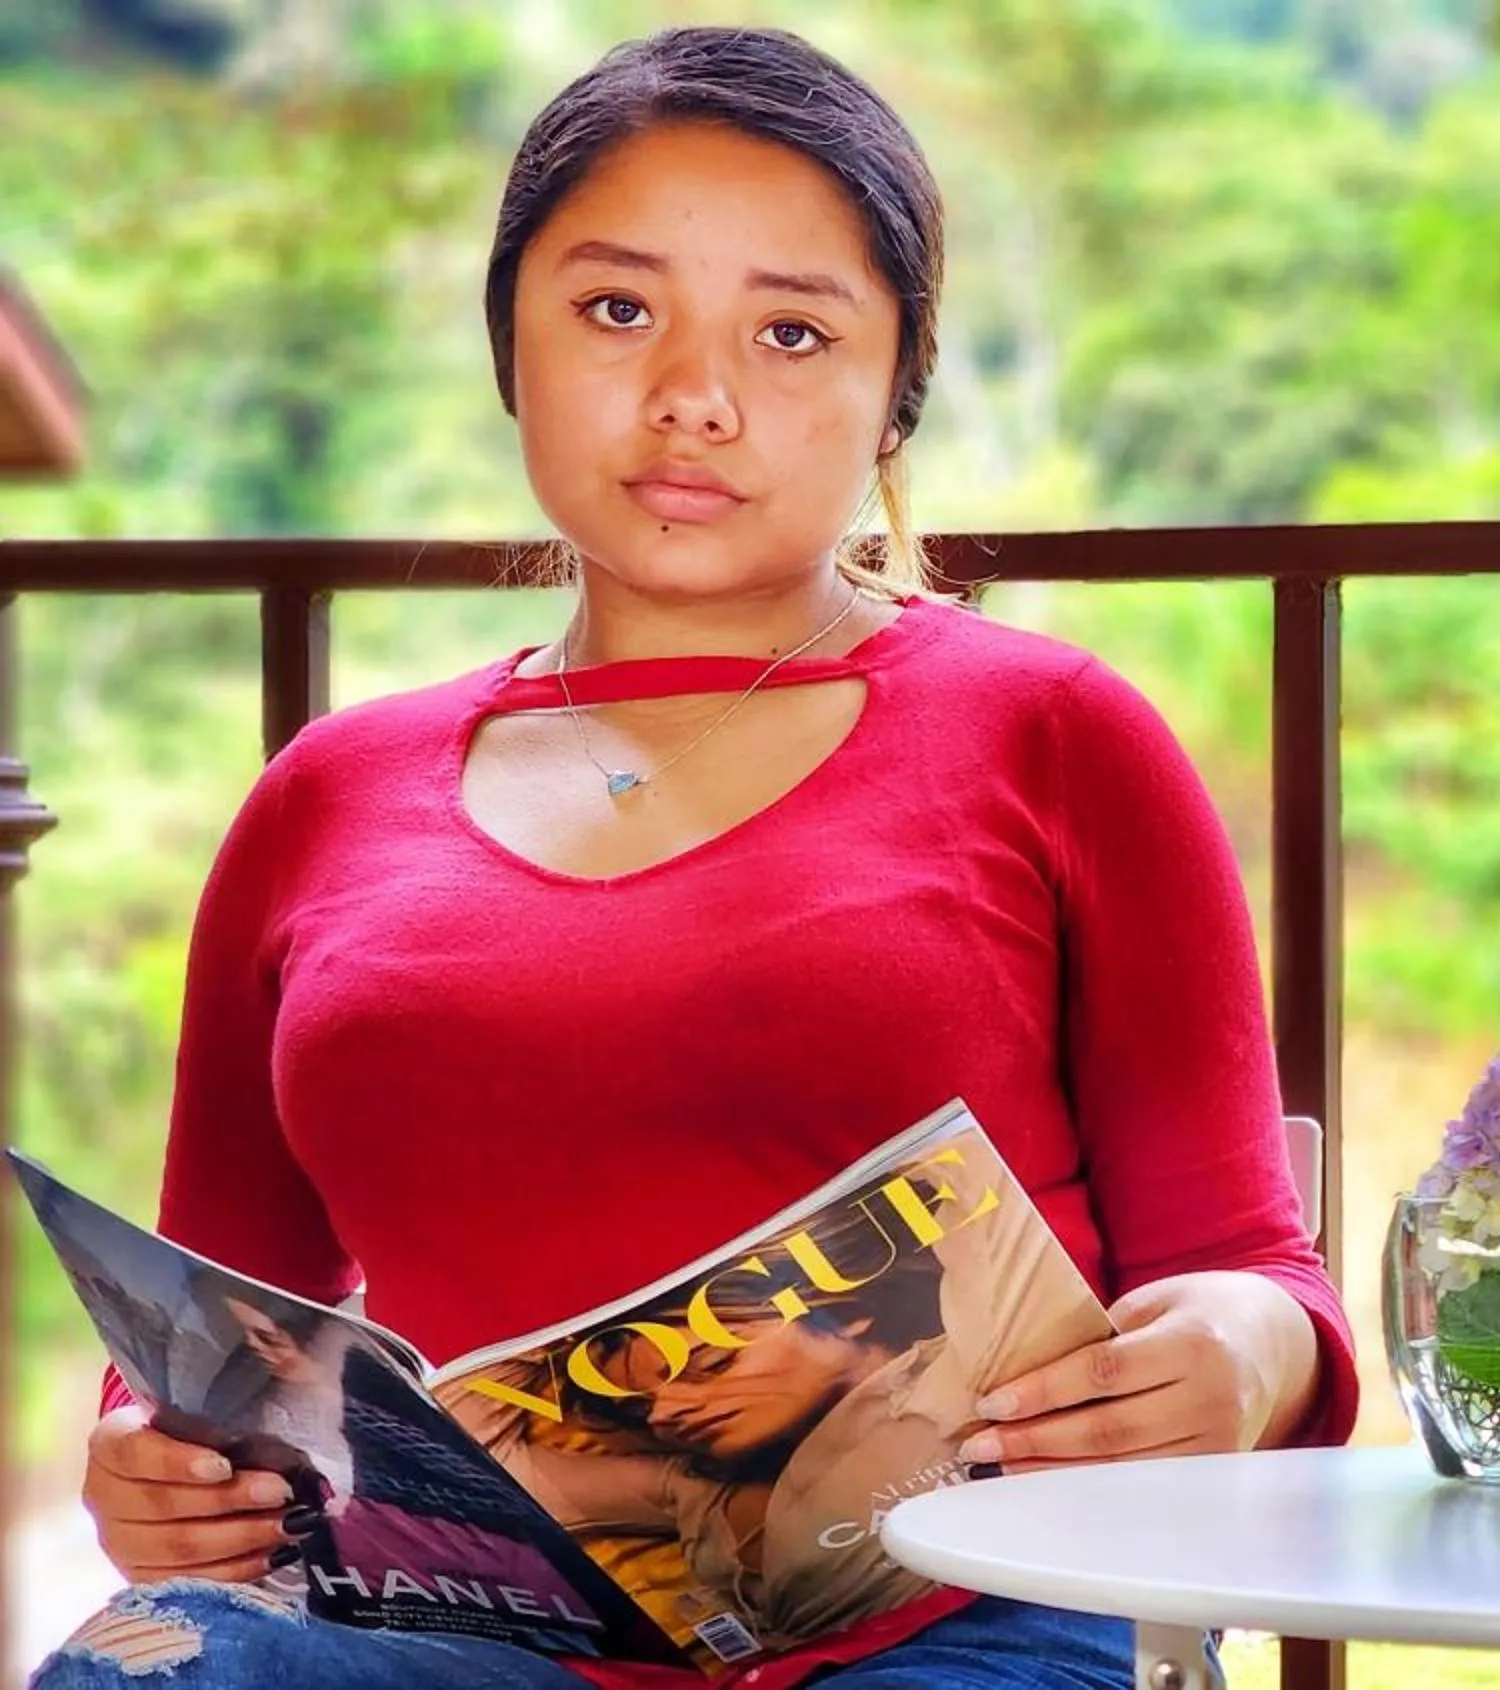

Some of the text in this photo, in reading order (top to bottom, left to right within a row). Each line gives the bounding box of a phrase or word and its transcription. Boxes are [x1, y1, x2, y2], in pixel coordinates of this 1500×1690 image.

[464, 1147, 999, 1422] VOGUE
[906, 1456, 964, 1490] ritm
[264, 1563, 604, 1628] CHANEL
